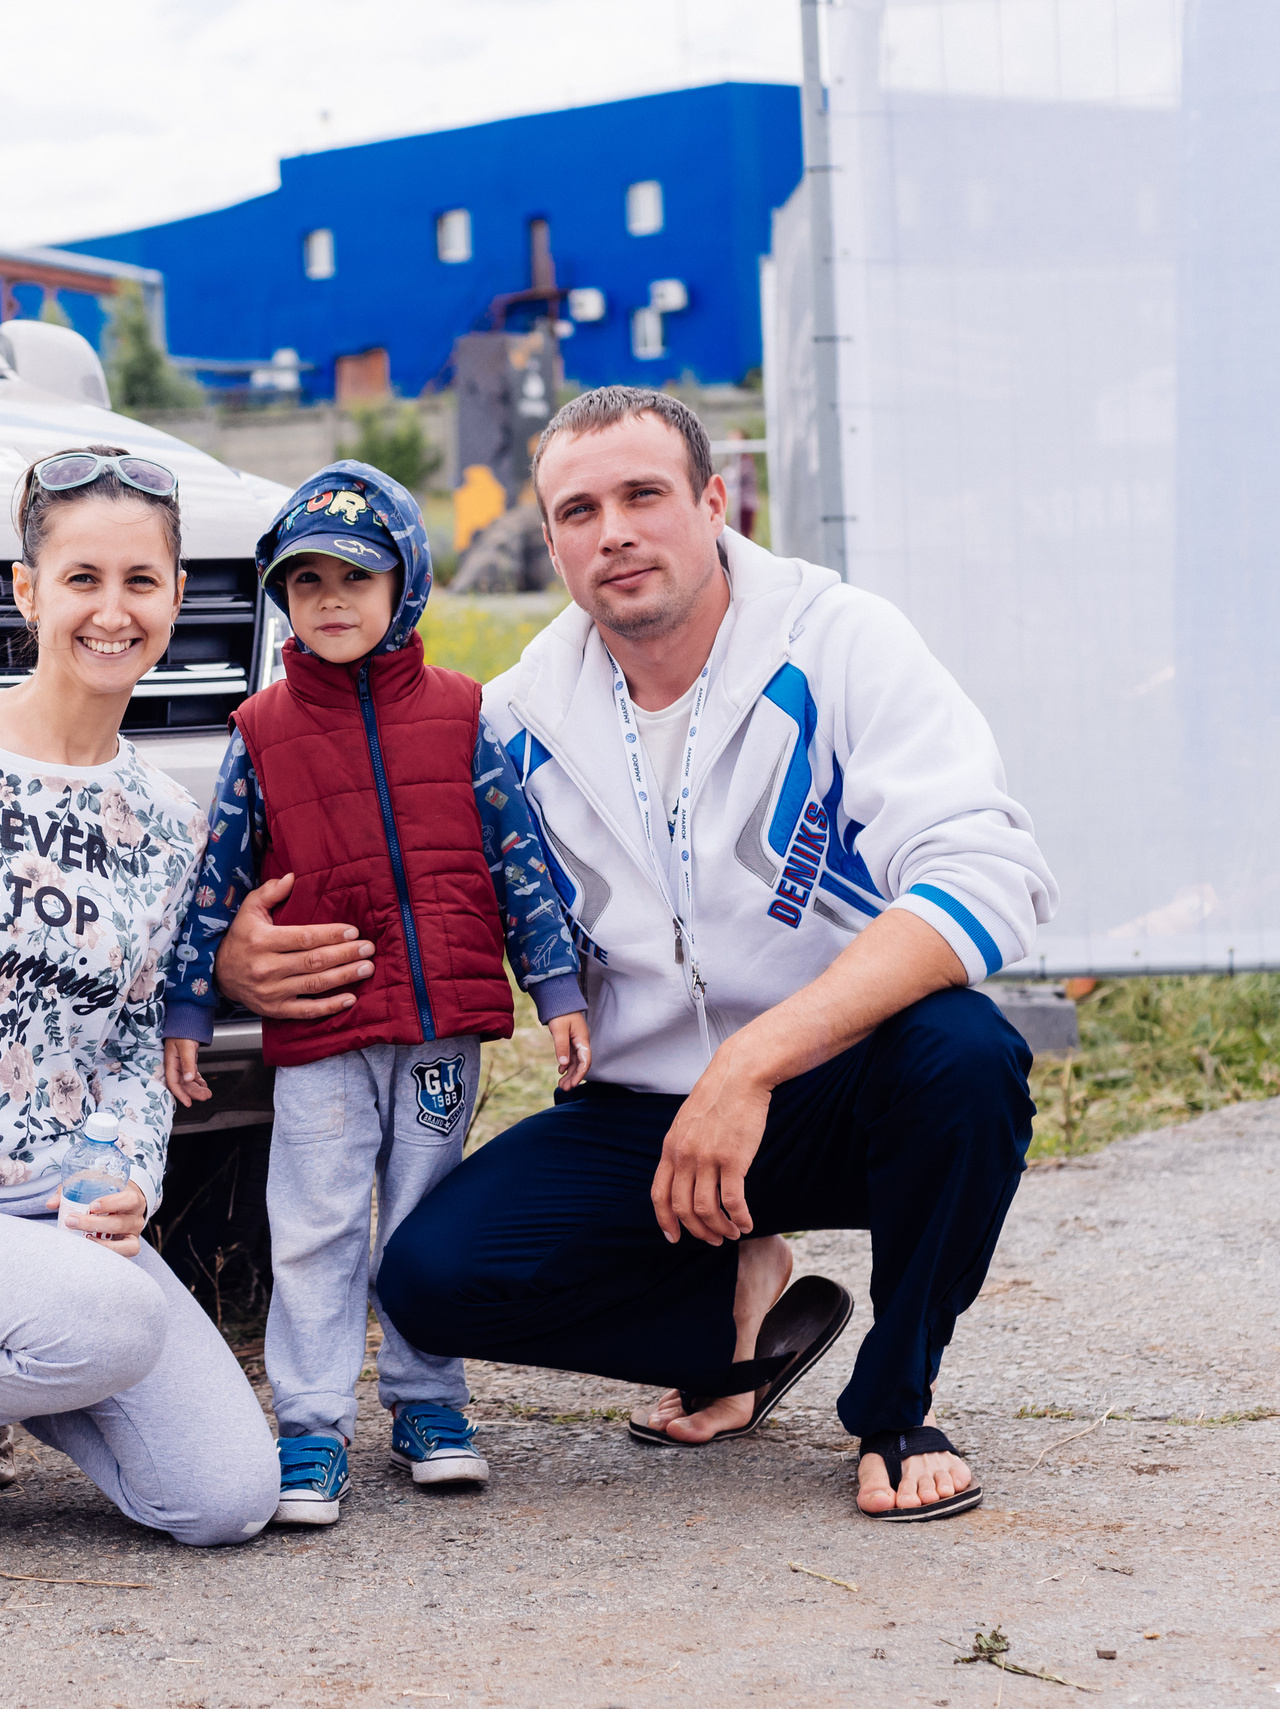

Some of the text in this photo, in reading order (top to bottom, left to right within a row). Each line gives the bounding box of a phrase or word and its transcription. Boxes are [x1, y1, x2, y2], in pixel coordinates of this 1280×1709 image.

[620, 697, 630, 724] AMAROK
[631, 752, 641, 782] AMAROK
[767, 801, 829, 929] DENIKS
[425, 1064, 455, 1095] GJ
